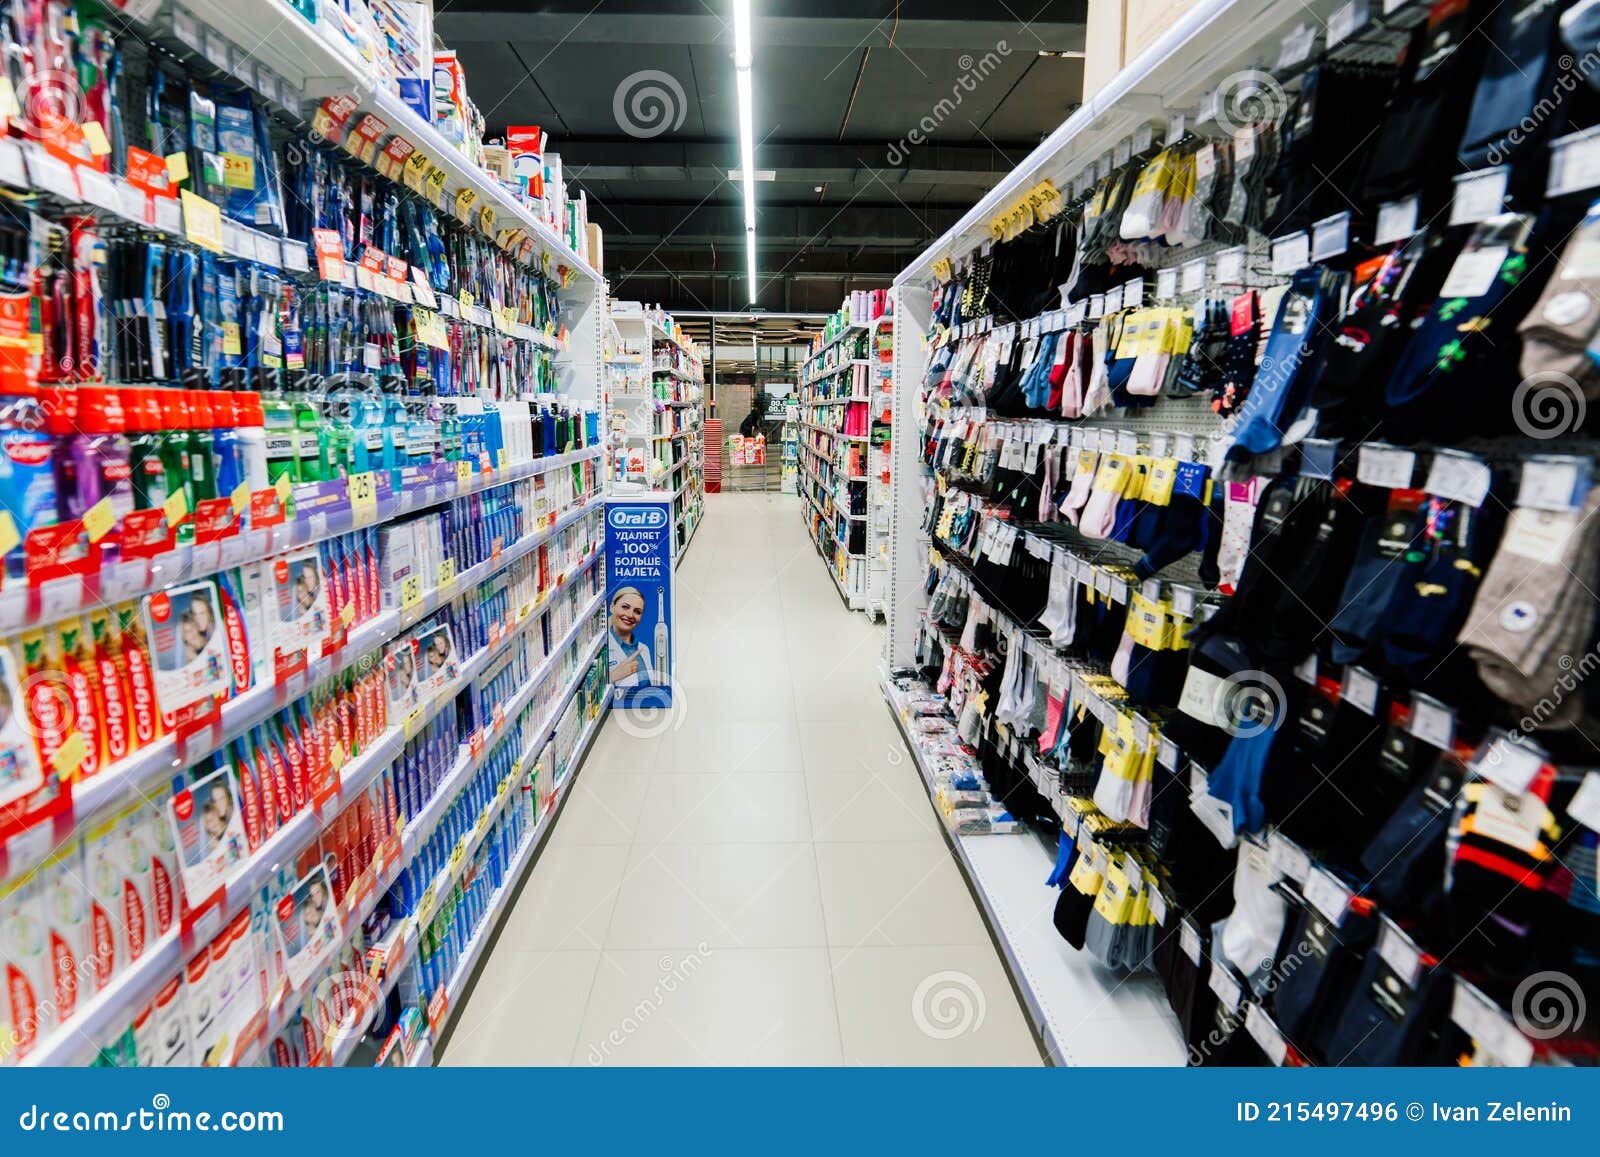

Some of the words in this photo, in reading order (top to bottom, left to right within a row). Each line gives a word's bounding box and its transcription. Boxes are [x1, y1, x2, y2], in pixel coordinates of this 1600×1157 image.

[613, 511, 661, 525] Oral-B
[615, 531, 661, 541] УДАЛЯЕТ
[623, 543, 658, 554] 100%
[615, 557, 661, 566] БОЛЬШЕ
[615, 567, 661, 577] НАЛЕТА
[226, 605, 249, 689] Colgate
[129, 649, 154, 741] Colgate
[101, 660, 127, 757] Colgate
[270, 746, 292, 817] Colgate
